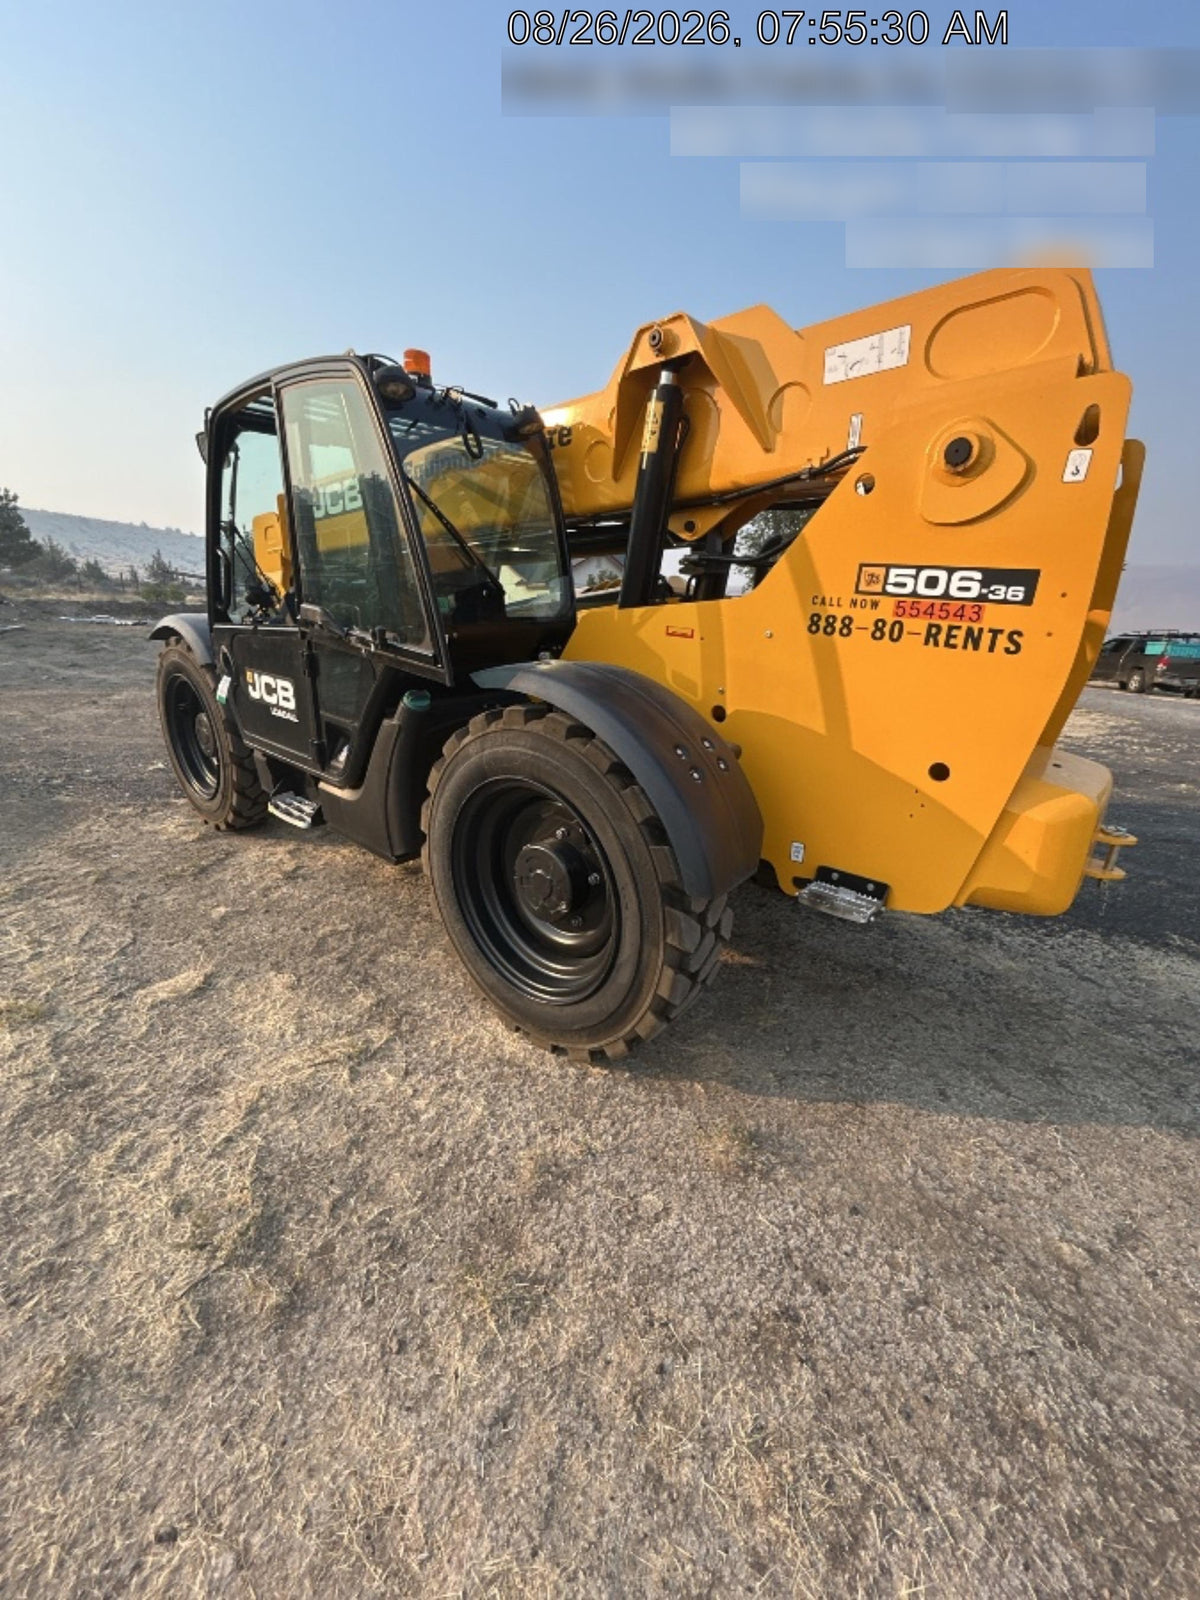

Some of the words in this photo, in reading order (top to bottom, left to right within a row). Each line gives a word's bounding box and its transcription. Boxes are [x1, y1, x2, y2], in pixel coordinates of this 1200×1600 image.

[312, 478, 363, 519] JCB
[885, 567, 1025, 601] 506-36
[811, 595, 844, 608] CALL
[849, 598, 881, 611] NOW
[895, 600, 983, 623] 554543
[807, 612, 1024, 655] 888-80-RENTS
[246, 670, 296, 710] JCB
